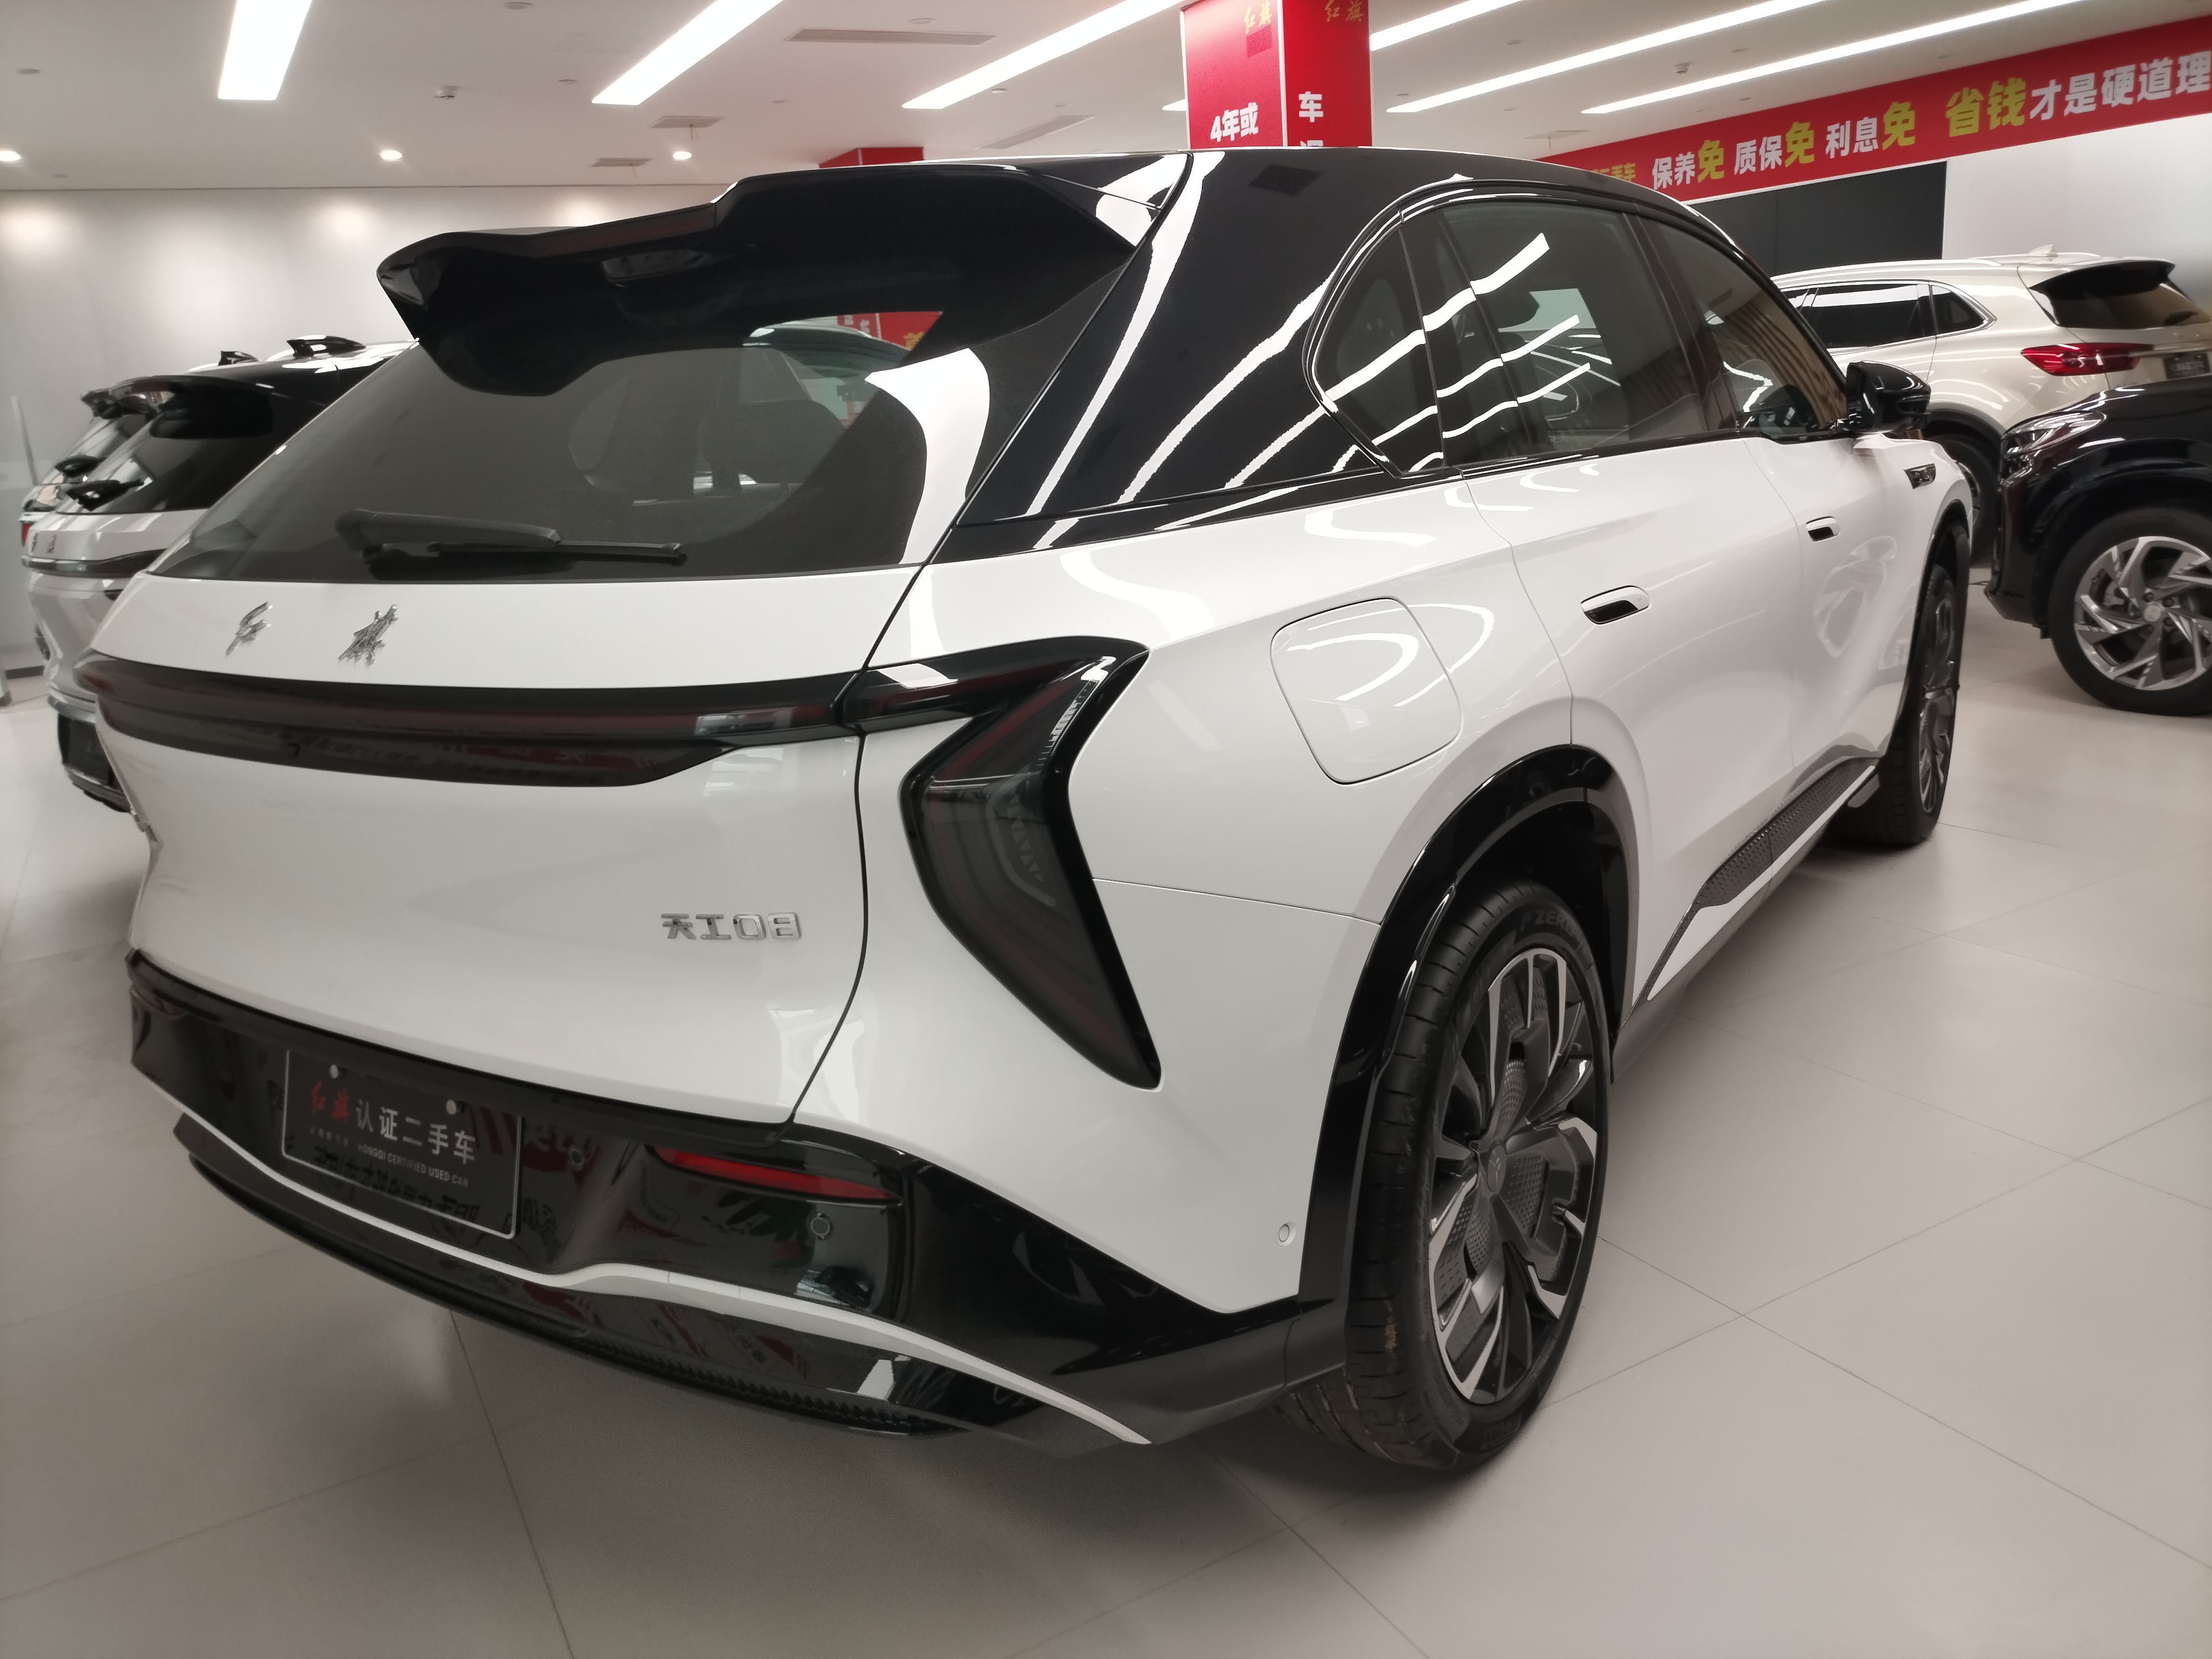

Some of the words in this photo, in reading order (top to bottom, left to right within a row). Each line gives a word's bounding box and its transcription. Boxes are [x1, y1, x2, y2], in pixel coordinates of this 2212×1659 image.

[1210, 102, 1259, 143] 4年或
[1651, 139, 1724, 190] 保养免
[1734, 121, 1814, 175] 质保免
[1825, 101, 1916, 159] 利息免
[1944, 50, 2212, 137] 省钱才是硬道理
[661, 912, 802, 941] 天工08
[358, 1144, 386, 1161] HONGQI
[388, 1152, 426, 1174] CERTIFIED
[429, 1166, 450, 1182] USED
[452, 1174, 469, 1188] CAR
